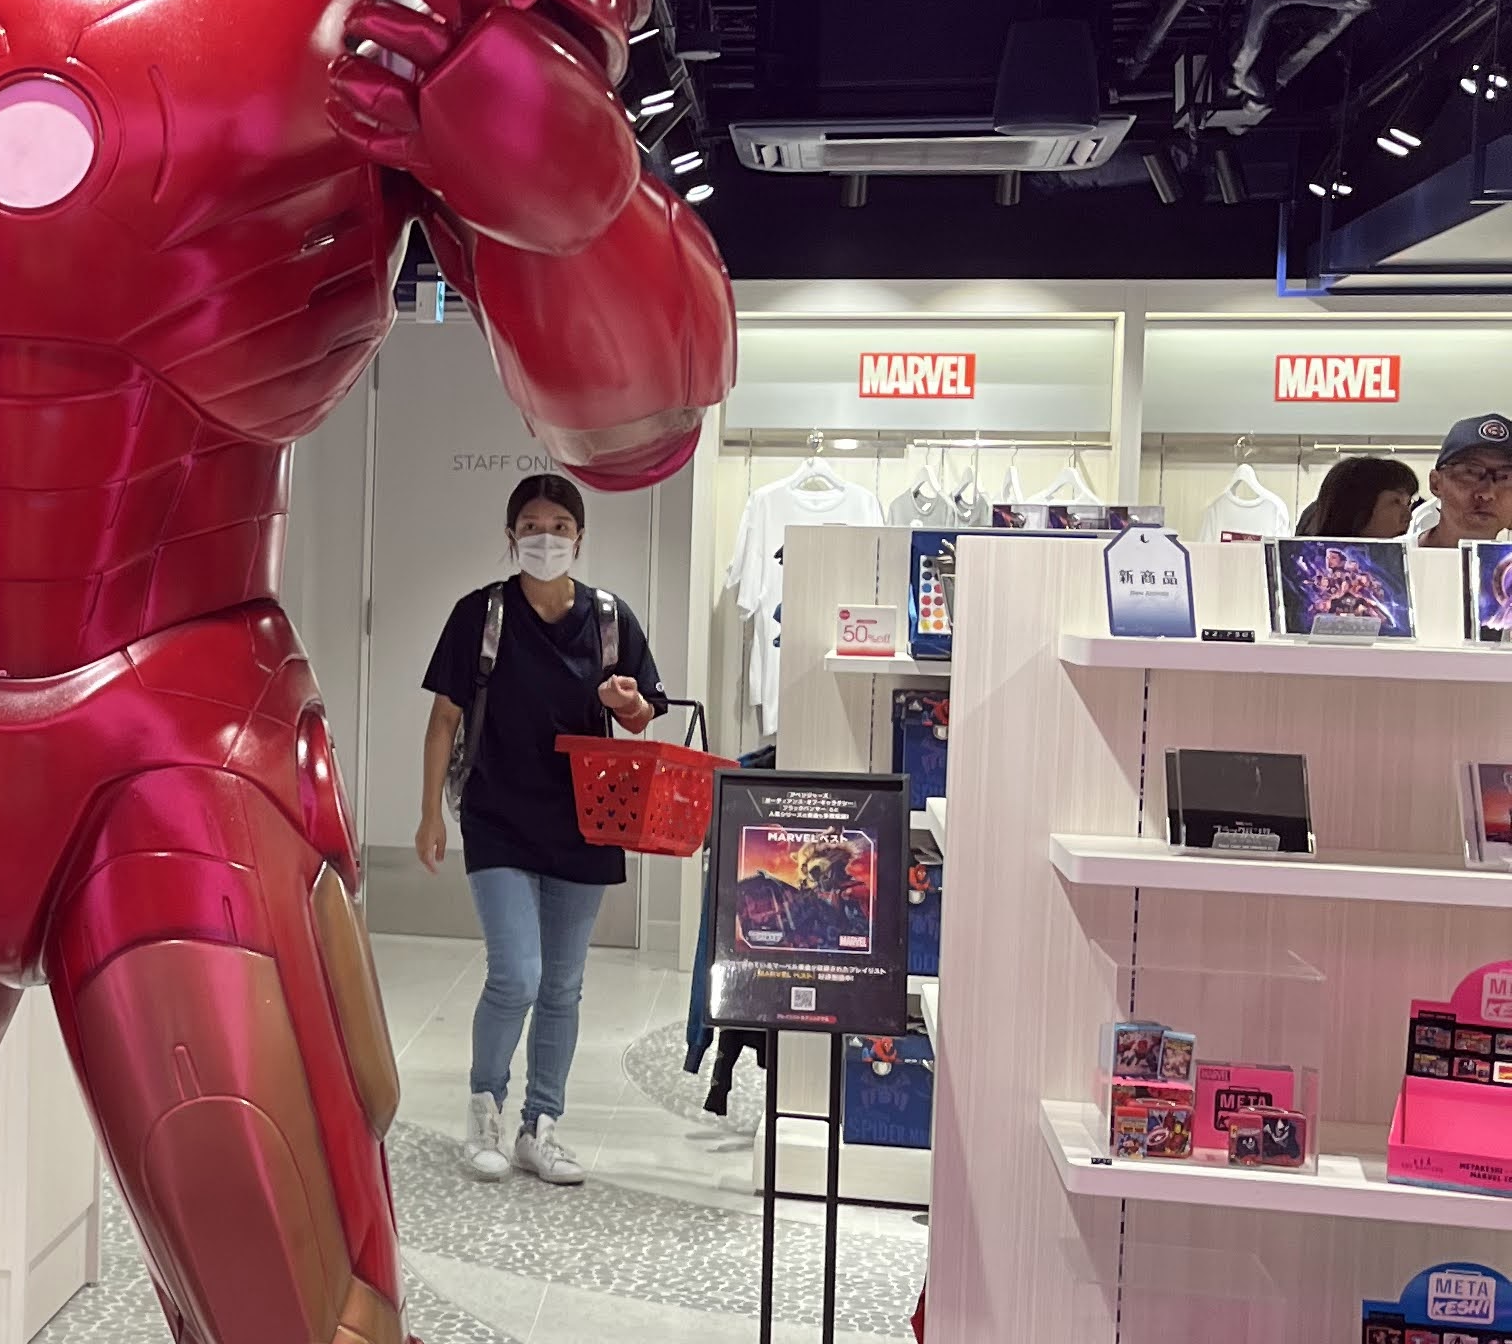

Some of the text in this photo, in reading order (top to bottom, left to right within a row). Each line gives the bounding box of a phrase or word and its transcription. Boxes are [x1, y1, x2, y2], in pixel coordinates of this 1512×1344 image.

[862, 355, 971, 395] MARVEL
[1278, 357, 1396, 398] MARVEL
[453, 455, 559, 472] STAFF ONL
[1119, 569, 1178, 585] 新商品
[1219, 1093, 1267, 1110] META
[1435, 1278, 1488, 1297] META
[1433, 1297, 1490, 1318] KESHI
